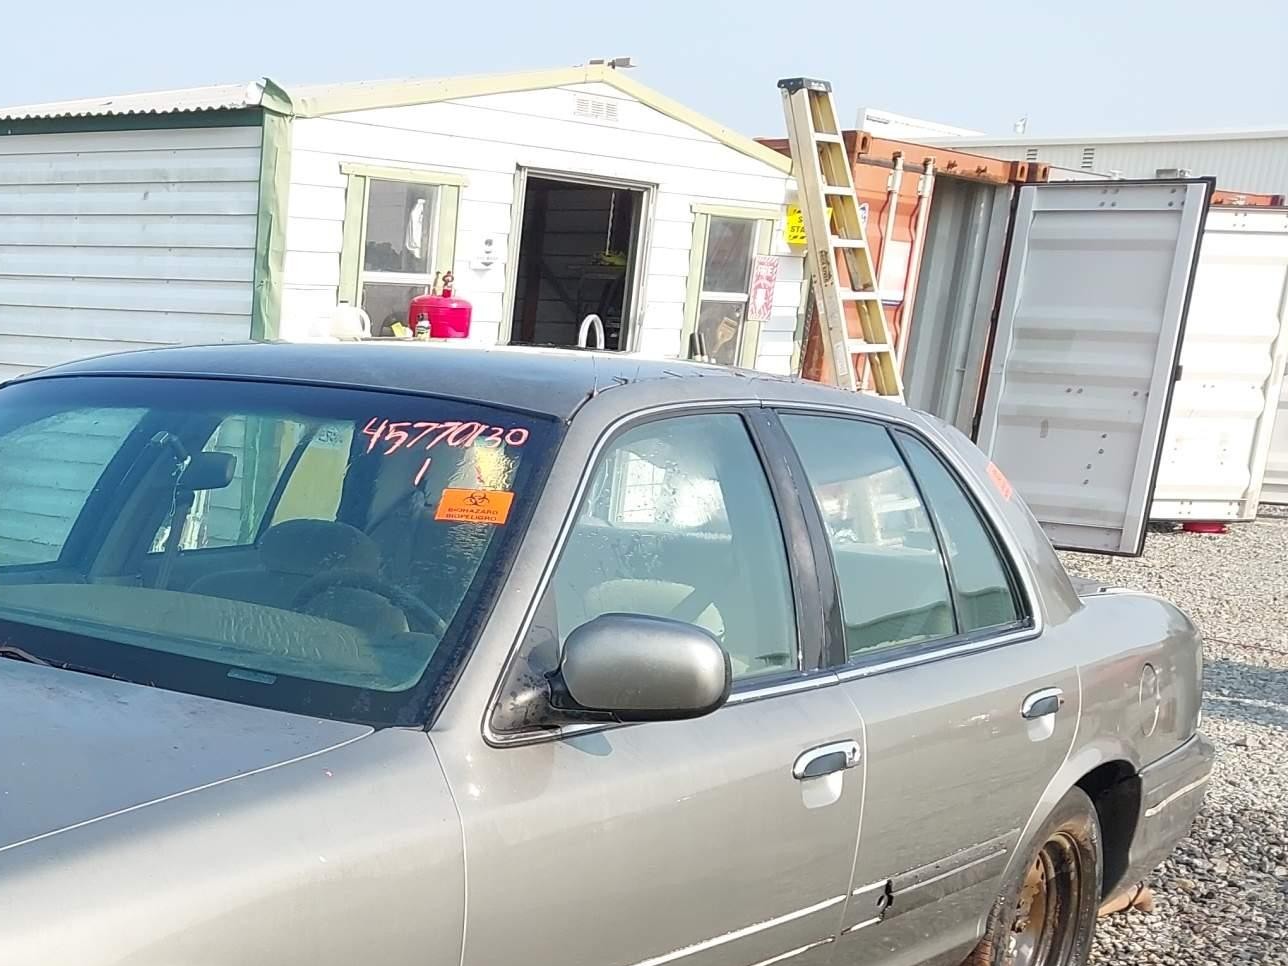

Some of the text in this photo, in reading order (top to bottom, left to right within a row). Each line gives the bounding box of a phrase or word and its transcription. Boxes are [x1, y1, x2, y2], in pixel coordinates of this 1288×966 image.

[363, 416, 529, 456] 45770130
[447, 507, 499, 515] BIOHAZARD
[445, 513, 497, 521] BIOPELIGRO
